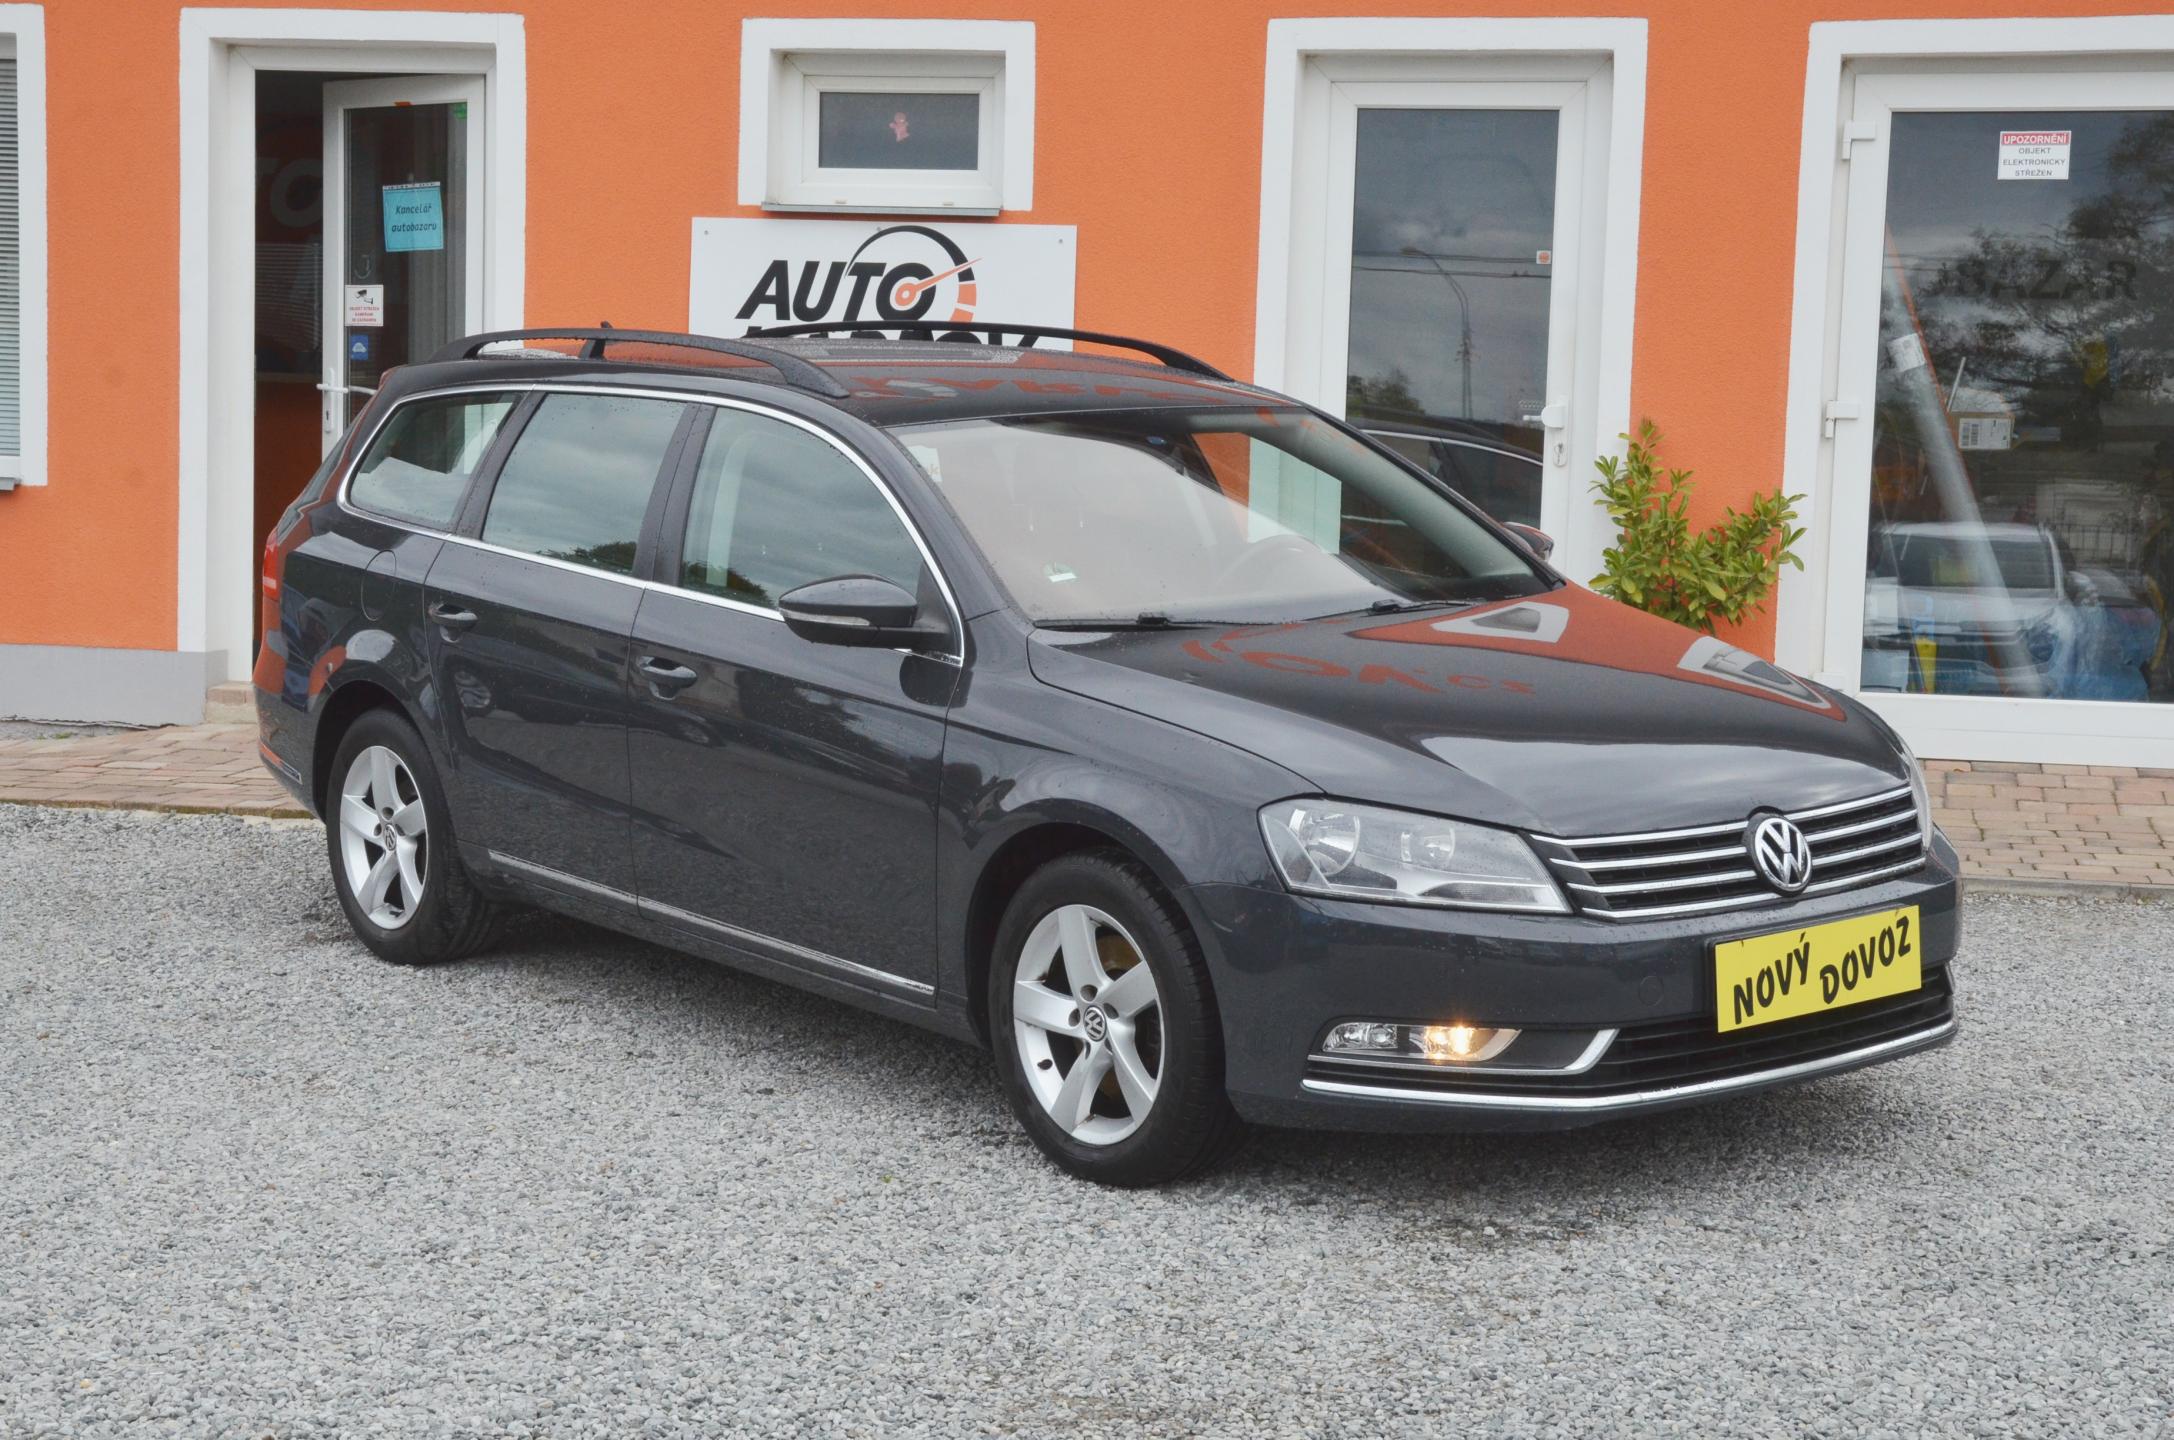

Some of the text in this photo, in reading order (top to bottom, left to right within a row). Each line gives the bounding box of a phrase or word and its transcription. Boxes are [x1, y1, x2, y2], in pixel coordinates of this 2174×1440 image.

[2003, 133, 2067, 145] UPOZORNĚNÍ
[395, 203, 432, 215] Kancelář
[391, 222, 437, 233] autobazaru
[734, 259, 937, 324] AUTO
[1733, 915, 1912, 1025] NOVÝ DOVOZ
